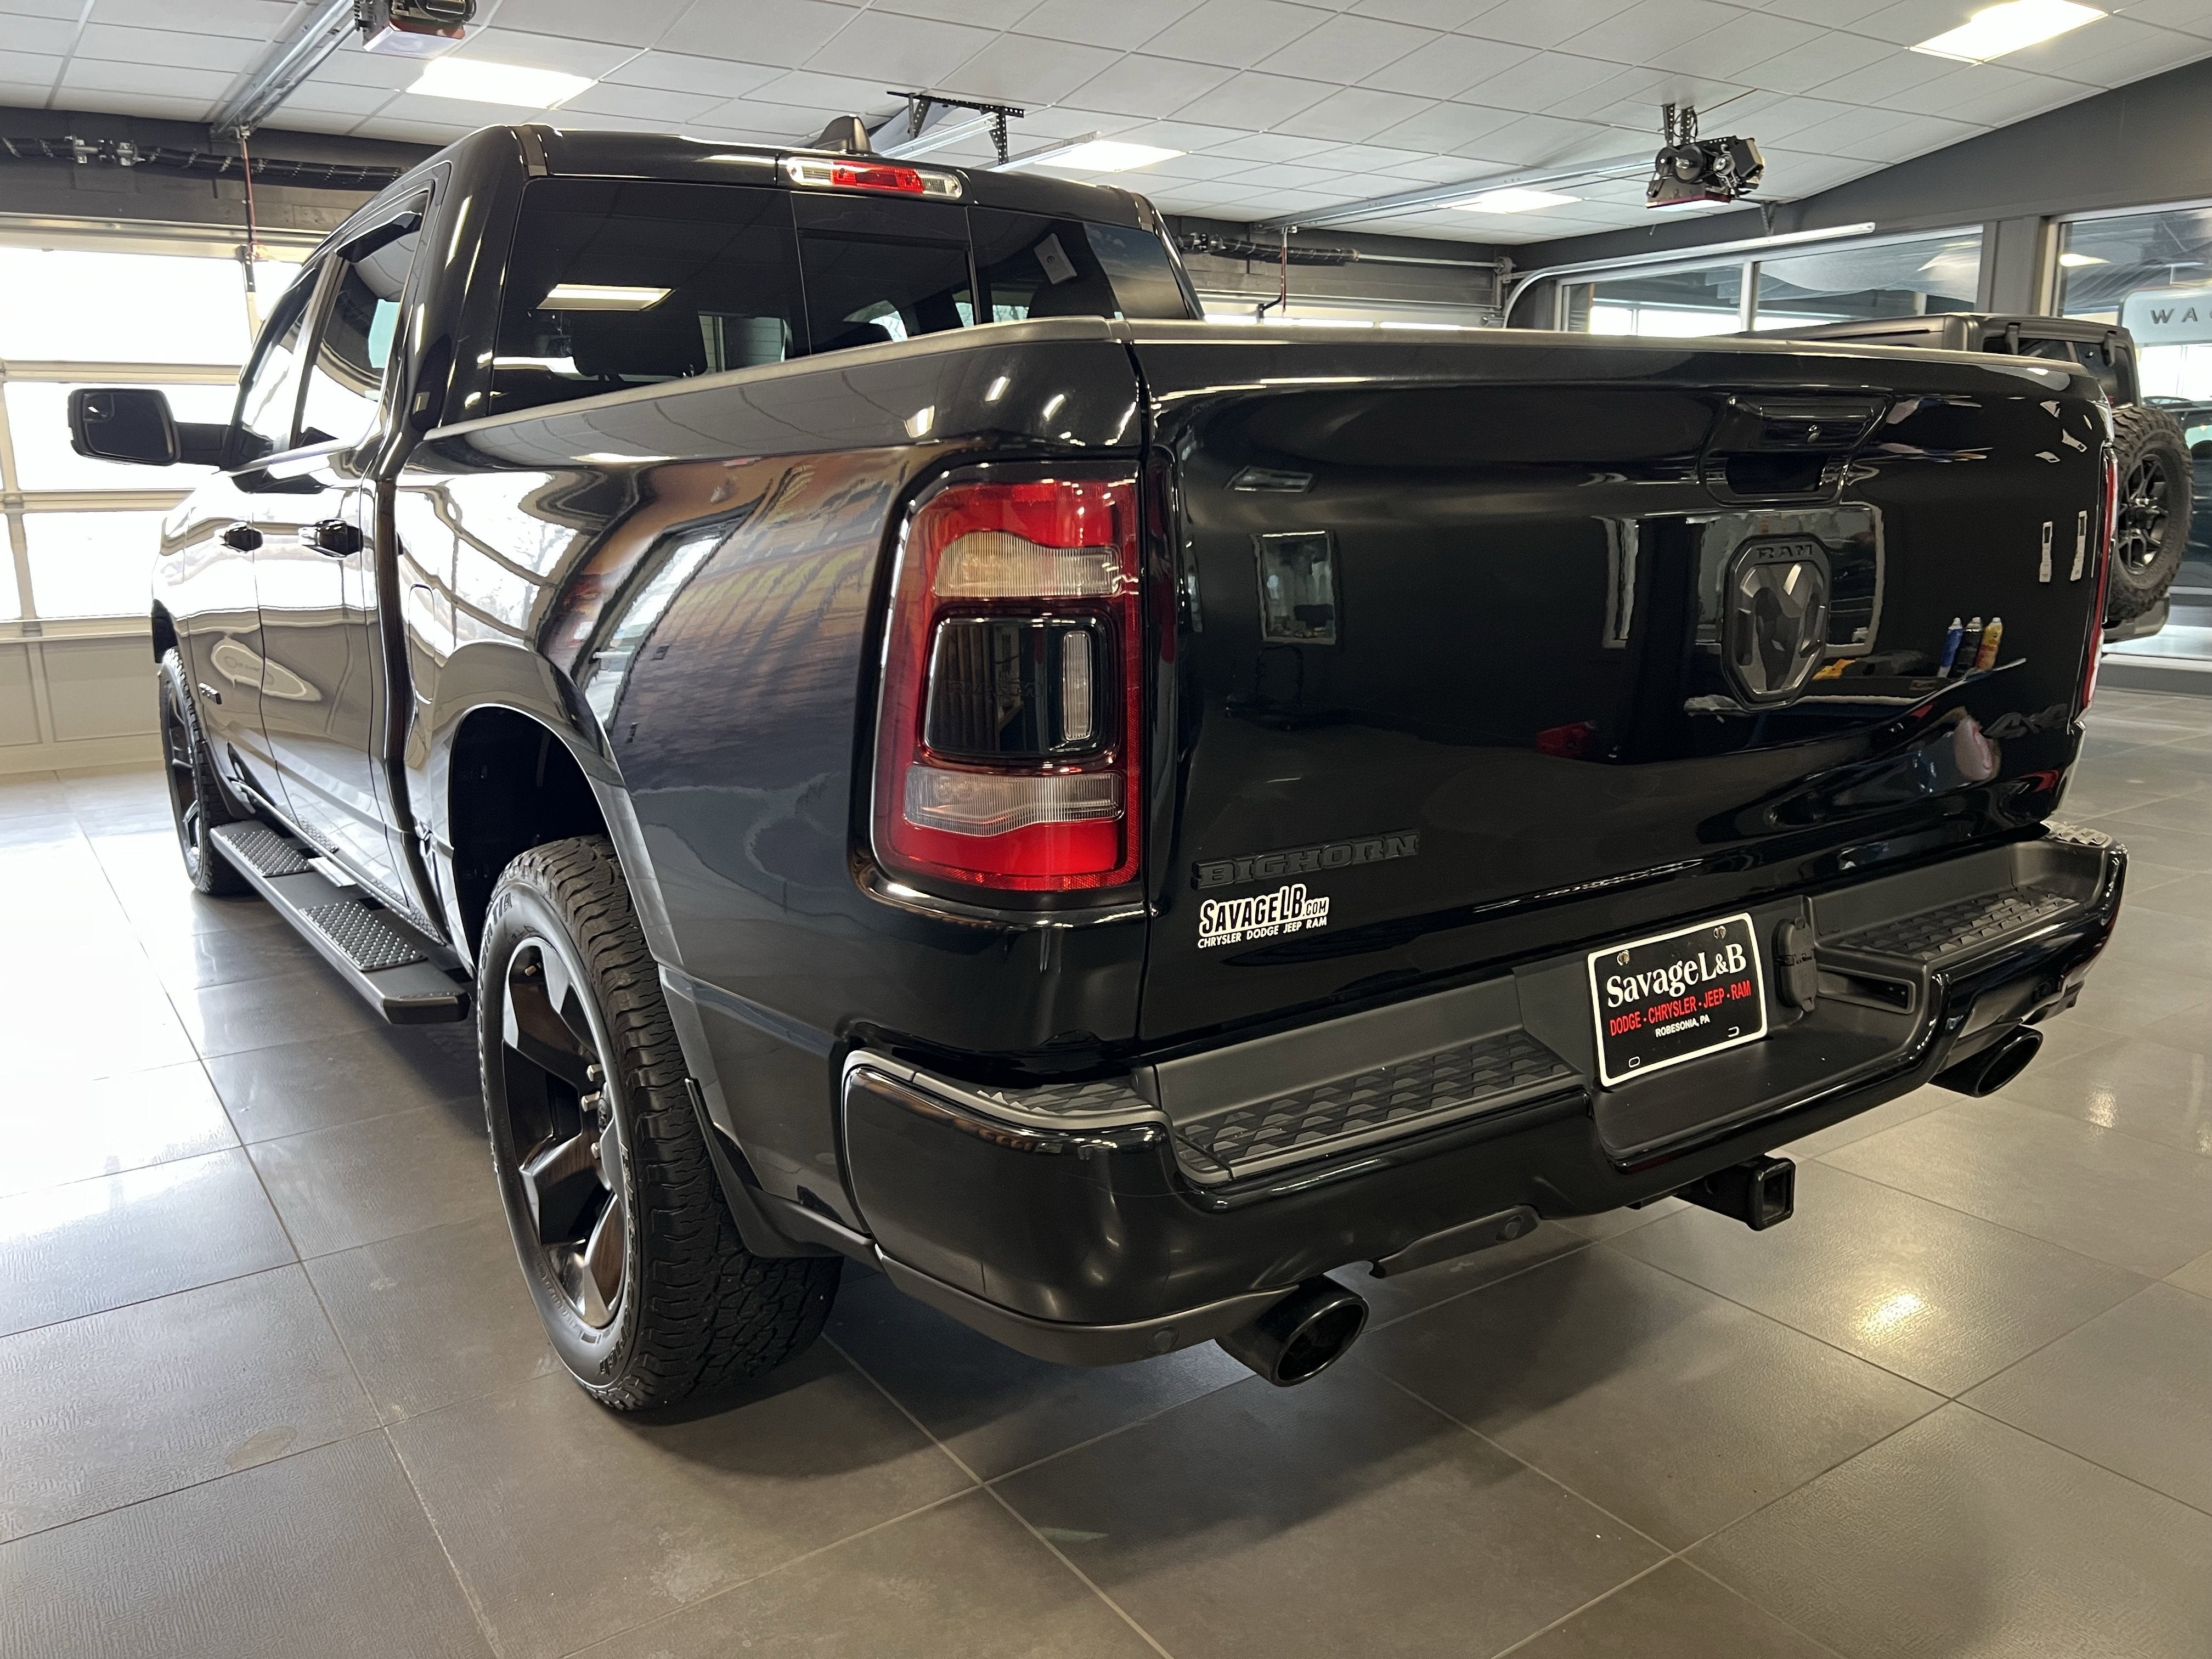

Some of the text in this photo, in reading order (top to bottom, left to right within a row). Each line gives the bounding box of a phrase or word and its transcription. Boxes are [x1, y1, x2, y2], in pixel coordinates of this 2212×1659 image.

[2149, 307, 2212, 325] WA
[1756, 544, 1813, 559] RAM
[1193, 830, 1419, 889] BIGHORN
[1198, 916, 1327, 949] CHRYSLER DODGE JEEP RAM
[1606, 943, 1747, 1008] SavageL&B
[1610, 980, 1751, 1036] DODGE CHRYSLER JEEP RAM
[1655, 1014, 1710, 1037] ROBESONIA, PA
